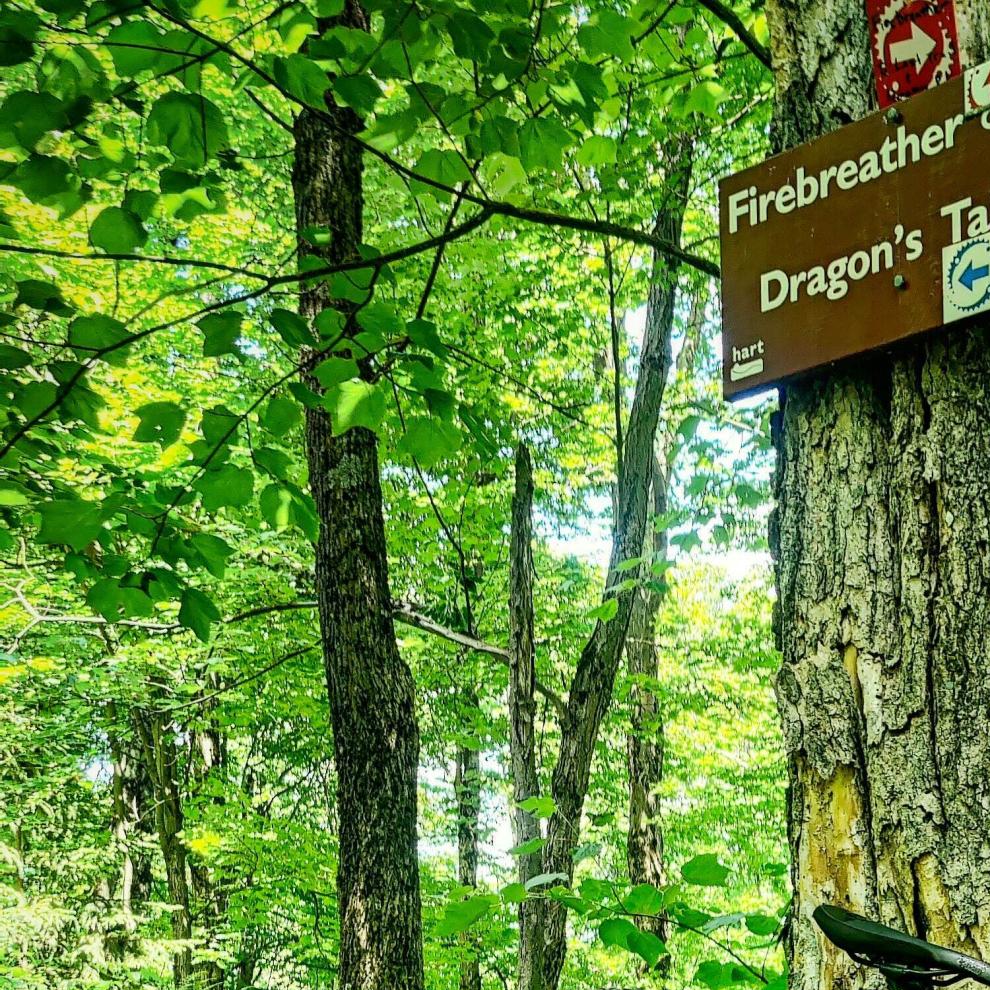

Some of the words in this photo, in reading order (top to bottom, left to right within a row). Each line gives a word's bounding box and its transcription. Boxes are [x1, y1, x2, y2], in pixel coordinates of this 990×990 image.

[728, 112, 963, 234] Firebreather
[760, 223, 924, 313] Dragon's
[732, 339, 764, 361] hart
